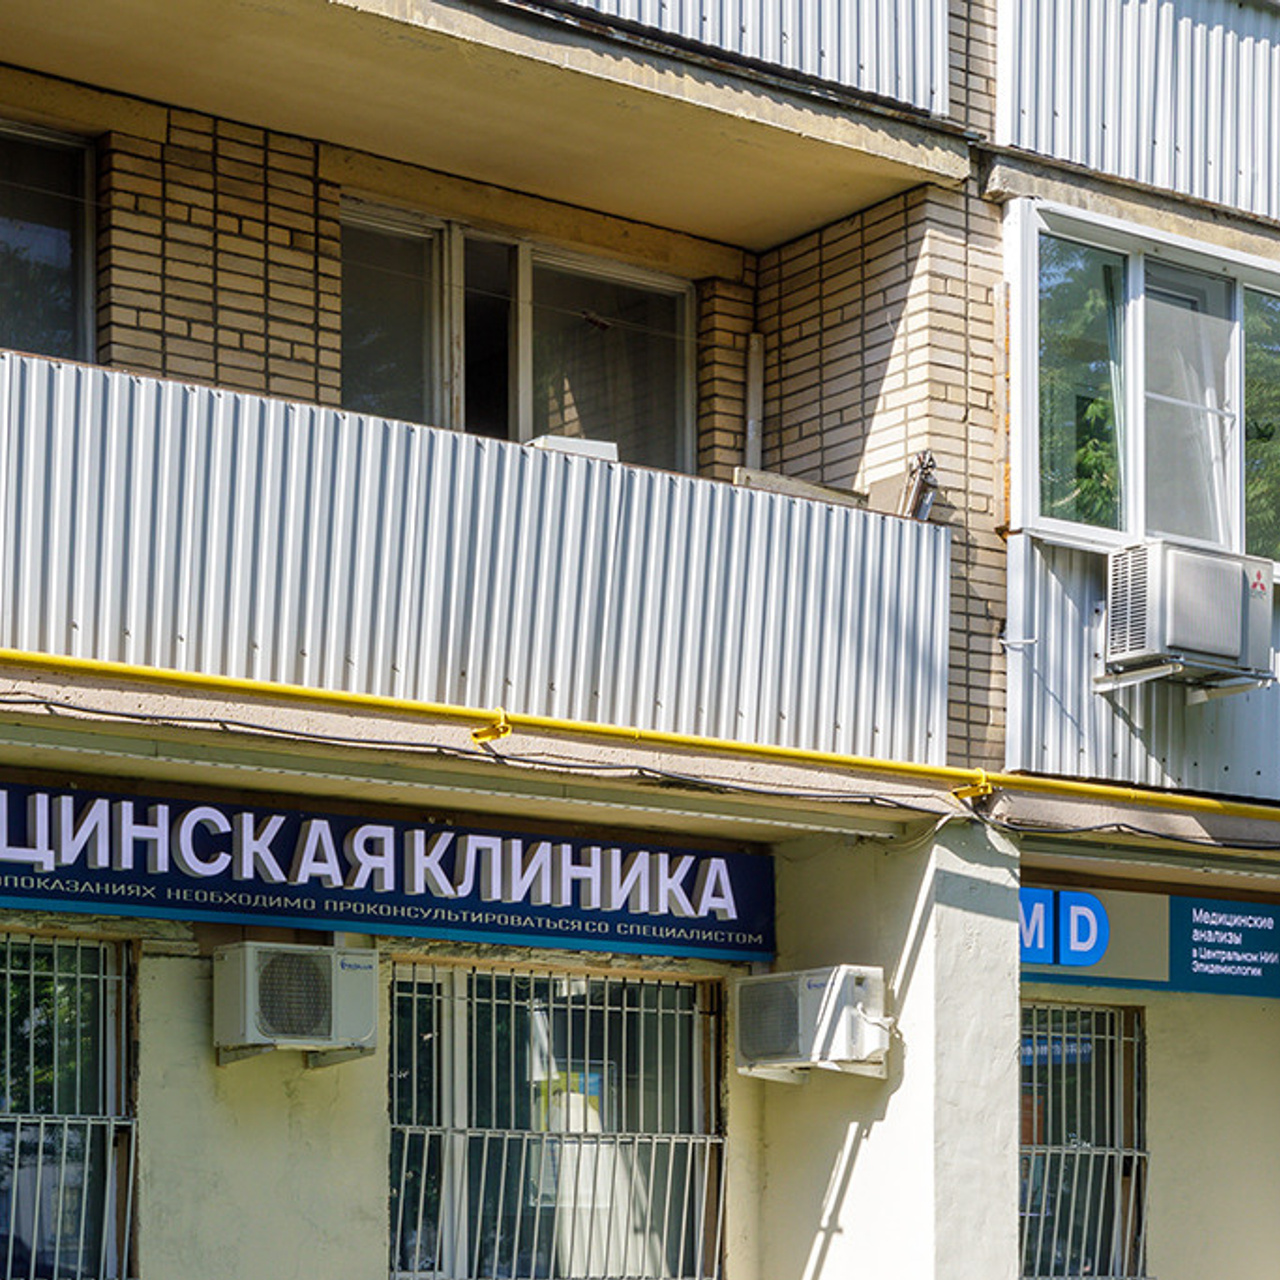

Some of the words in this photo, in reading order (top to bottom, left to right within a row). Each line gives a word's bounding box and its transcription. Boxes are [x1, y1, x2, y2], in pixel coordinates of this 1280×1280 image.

[404, 828, 738, 922] КЛИНИКА
[166, 887, 316, 911] НЕОБХОДИМО
[323, 899, 582, 932] ПРОКОНСУЛЬТИРОВАТЬСЯ
[584, 920, 610, 933] СО
[616, 922, 764, 945] СПЕЦИАЛИСТОМ
[1191, 907, 1275, 930] Медицинские
[1191, 928, 1243, 945] анализы
[1199, 946, 1259, 963] Центральном
